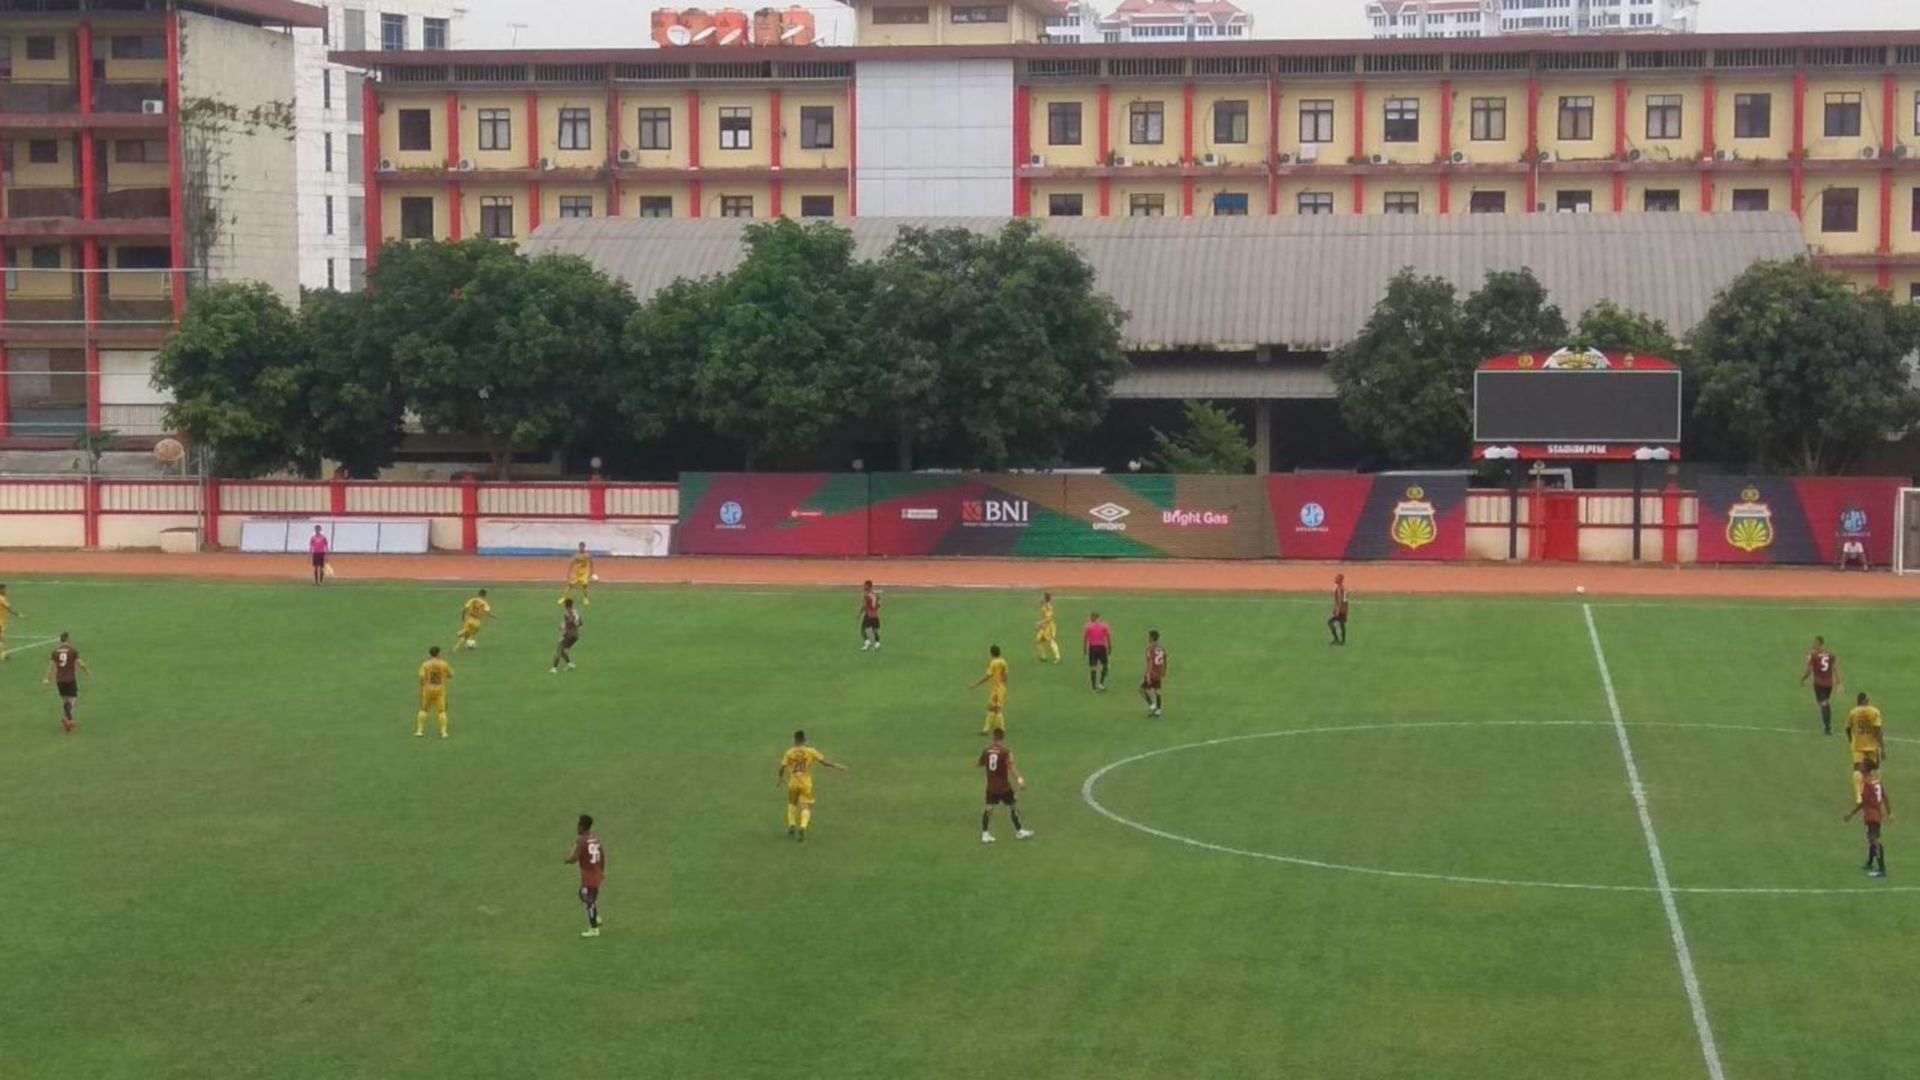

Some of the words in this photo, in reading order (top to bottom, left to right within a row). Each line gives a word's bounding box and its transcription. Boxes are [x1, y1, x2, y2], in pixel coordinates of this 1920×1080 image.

[985, 500, 1028, 521] BNI
[1163, 510, 1201, 526] Bright
[1203, 512, 1228, 524] Gas
[1092, 522, 1126, 530] umbro
[59, 652, 67, 667] 9
[1820, 656, 1829, 671] 5
